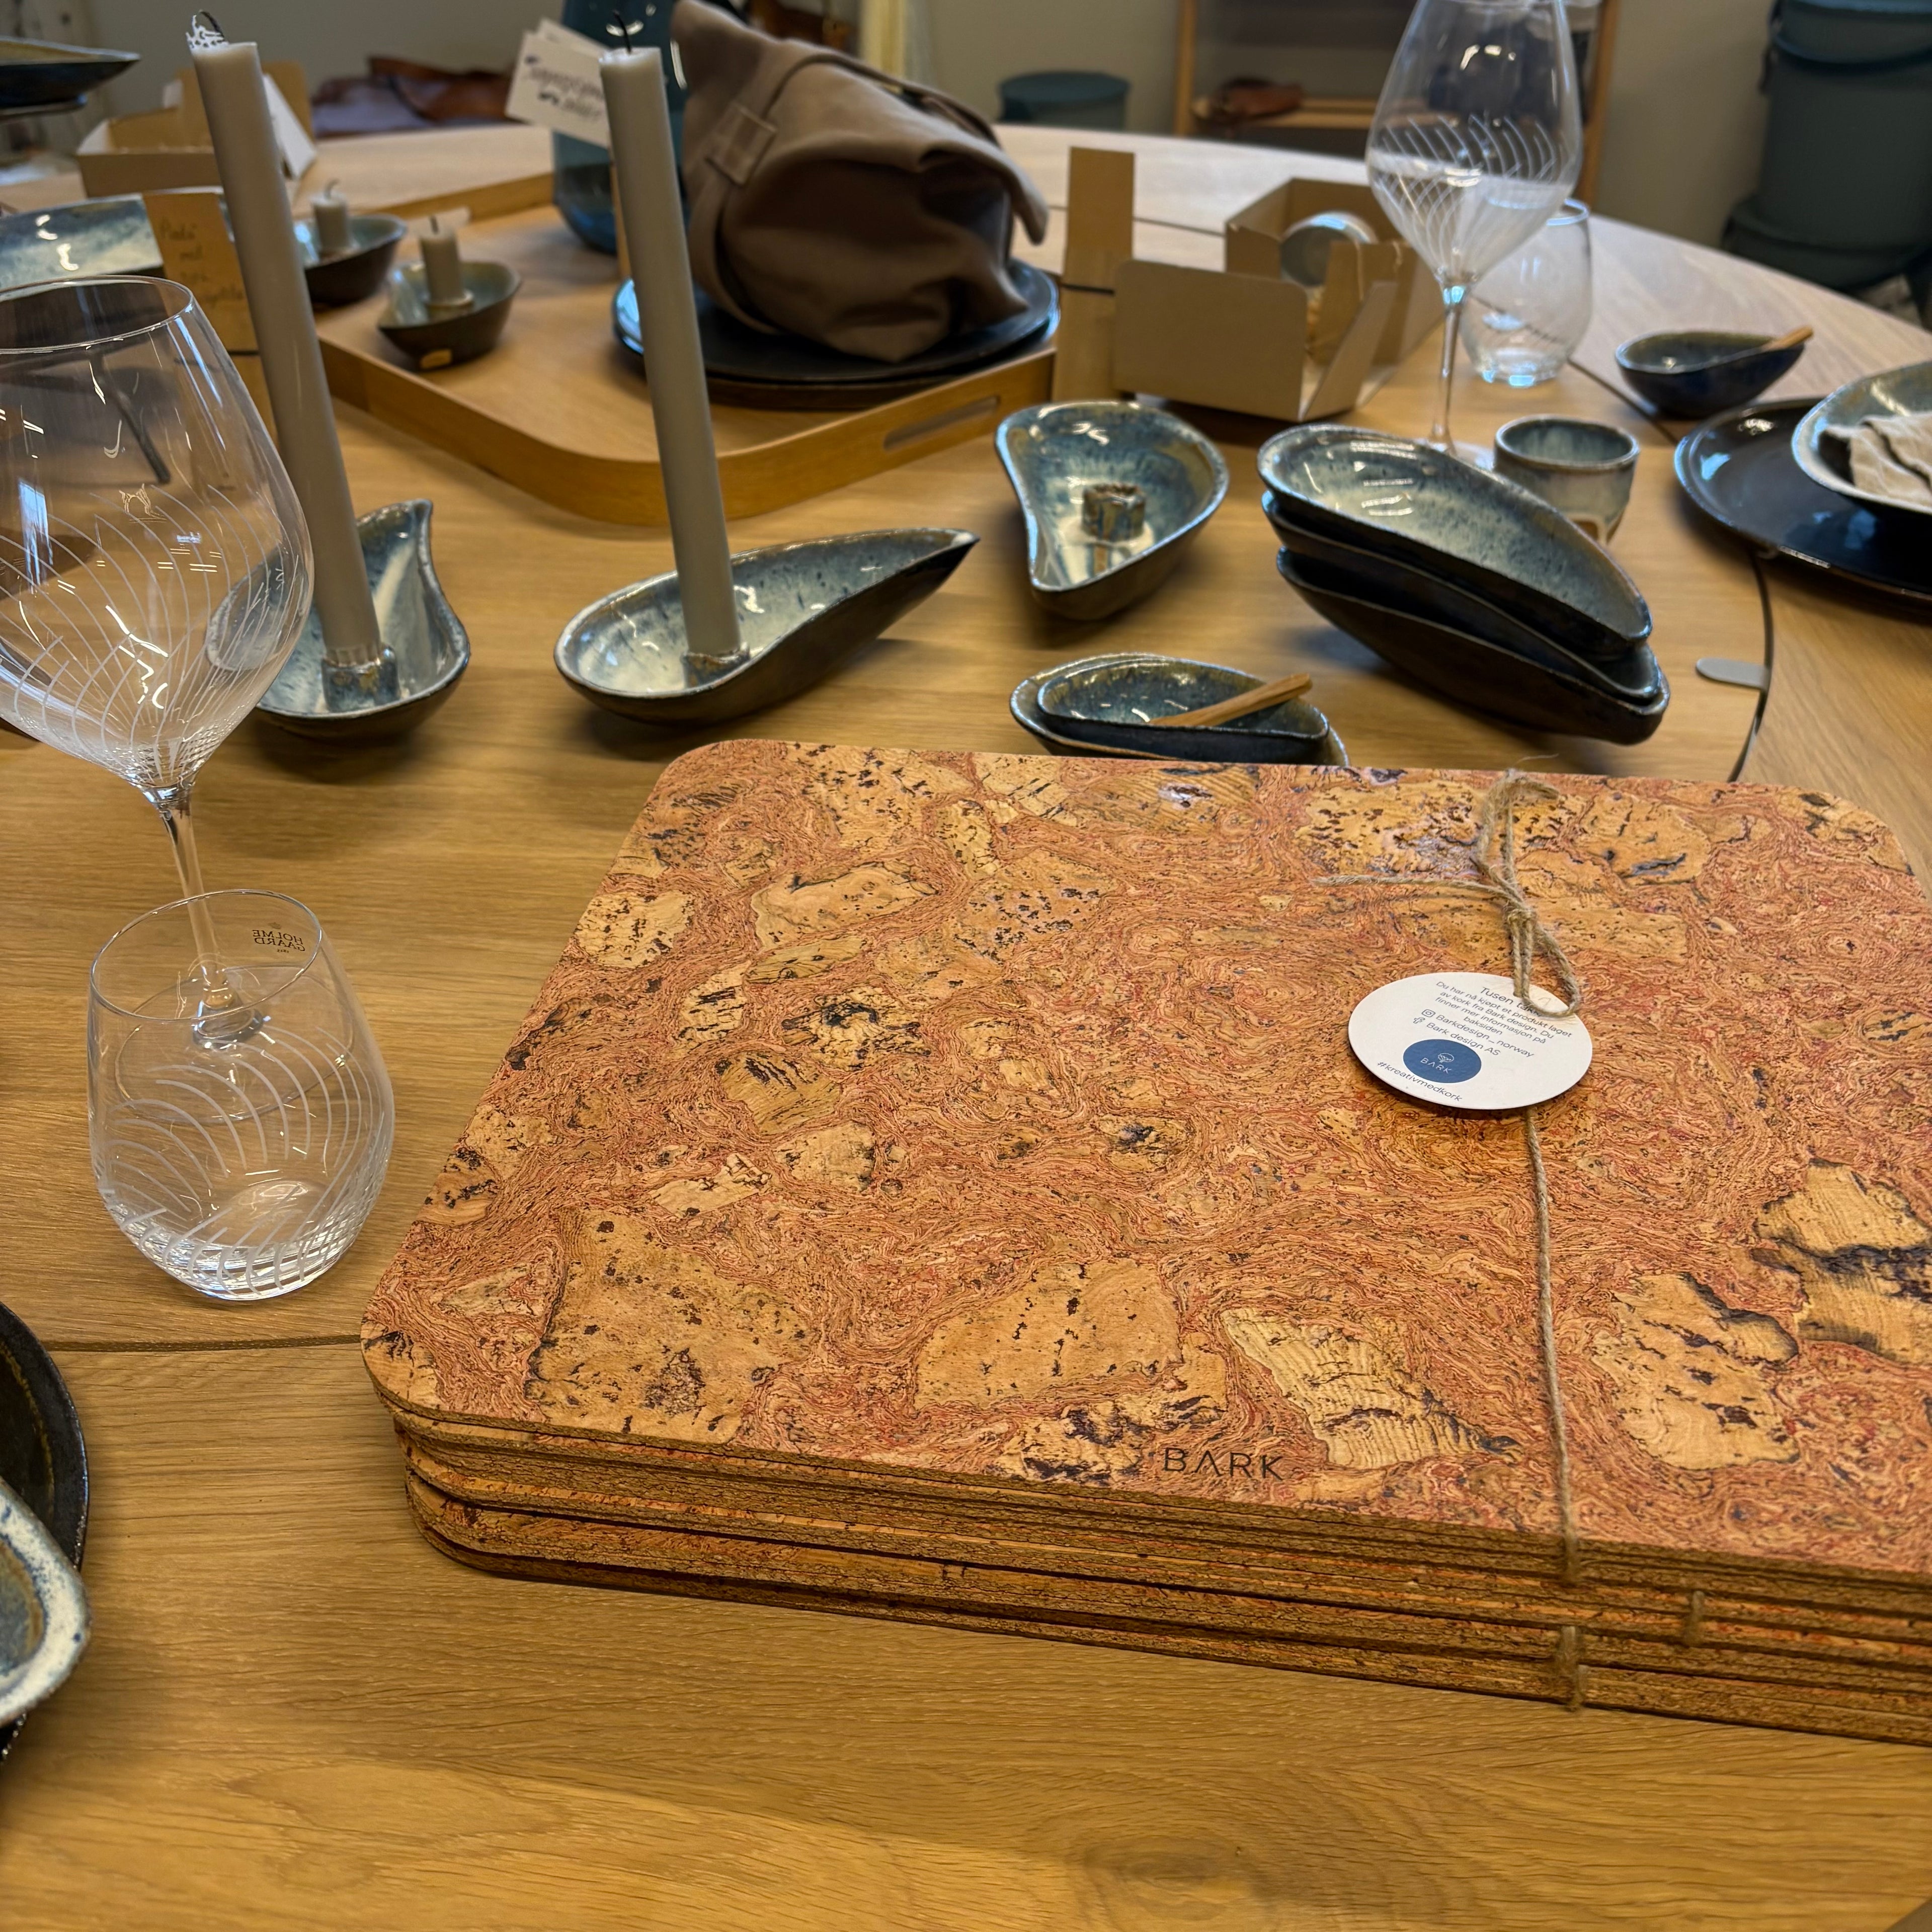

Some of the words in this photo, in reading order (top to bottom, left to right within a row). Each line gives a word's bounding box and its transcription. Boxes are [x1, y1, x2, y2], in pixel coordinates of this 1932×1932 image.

[1450, 987, 1464, 995] har
[1478, 997, 1501, 1010] kjøpt
[1511, 1012, 1548, 1028] produkt
[1548, 1025, 1572, 1037] laget
[1480, 986, 1513, 1005] Tusen
[1435, 997, 1461, 1009] finner
[1462, 1008, 1480, 1016] mer
[1481, 1014, 1533, 1039] informasjon
[1453, 996, 1471, 1005] kork
[1486, 1009, 1505, 1019] Bark
[1507, 1017, 1538, 1033] design.
[1540, 1030, 1554, 1039] Du
[1463, 1016, 1503, 1035] baksiden
[1426, 1022, 1450, 1035] Bark
[1451, 1033, 1484, 1050] design
[1484, 1047, 1501, 1056] AS
[1377, 1062, 1463, 1102] #kreativmedkork
[1420, 1058, 1452, 1074] BARK
[1163, 1447, 1284, 1481] BARK
